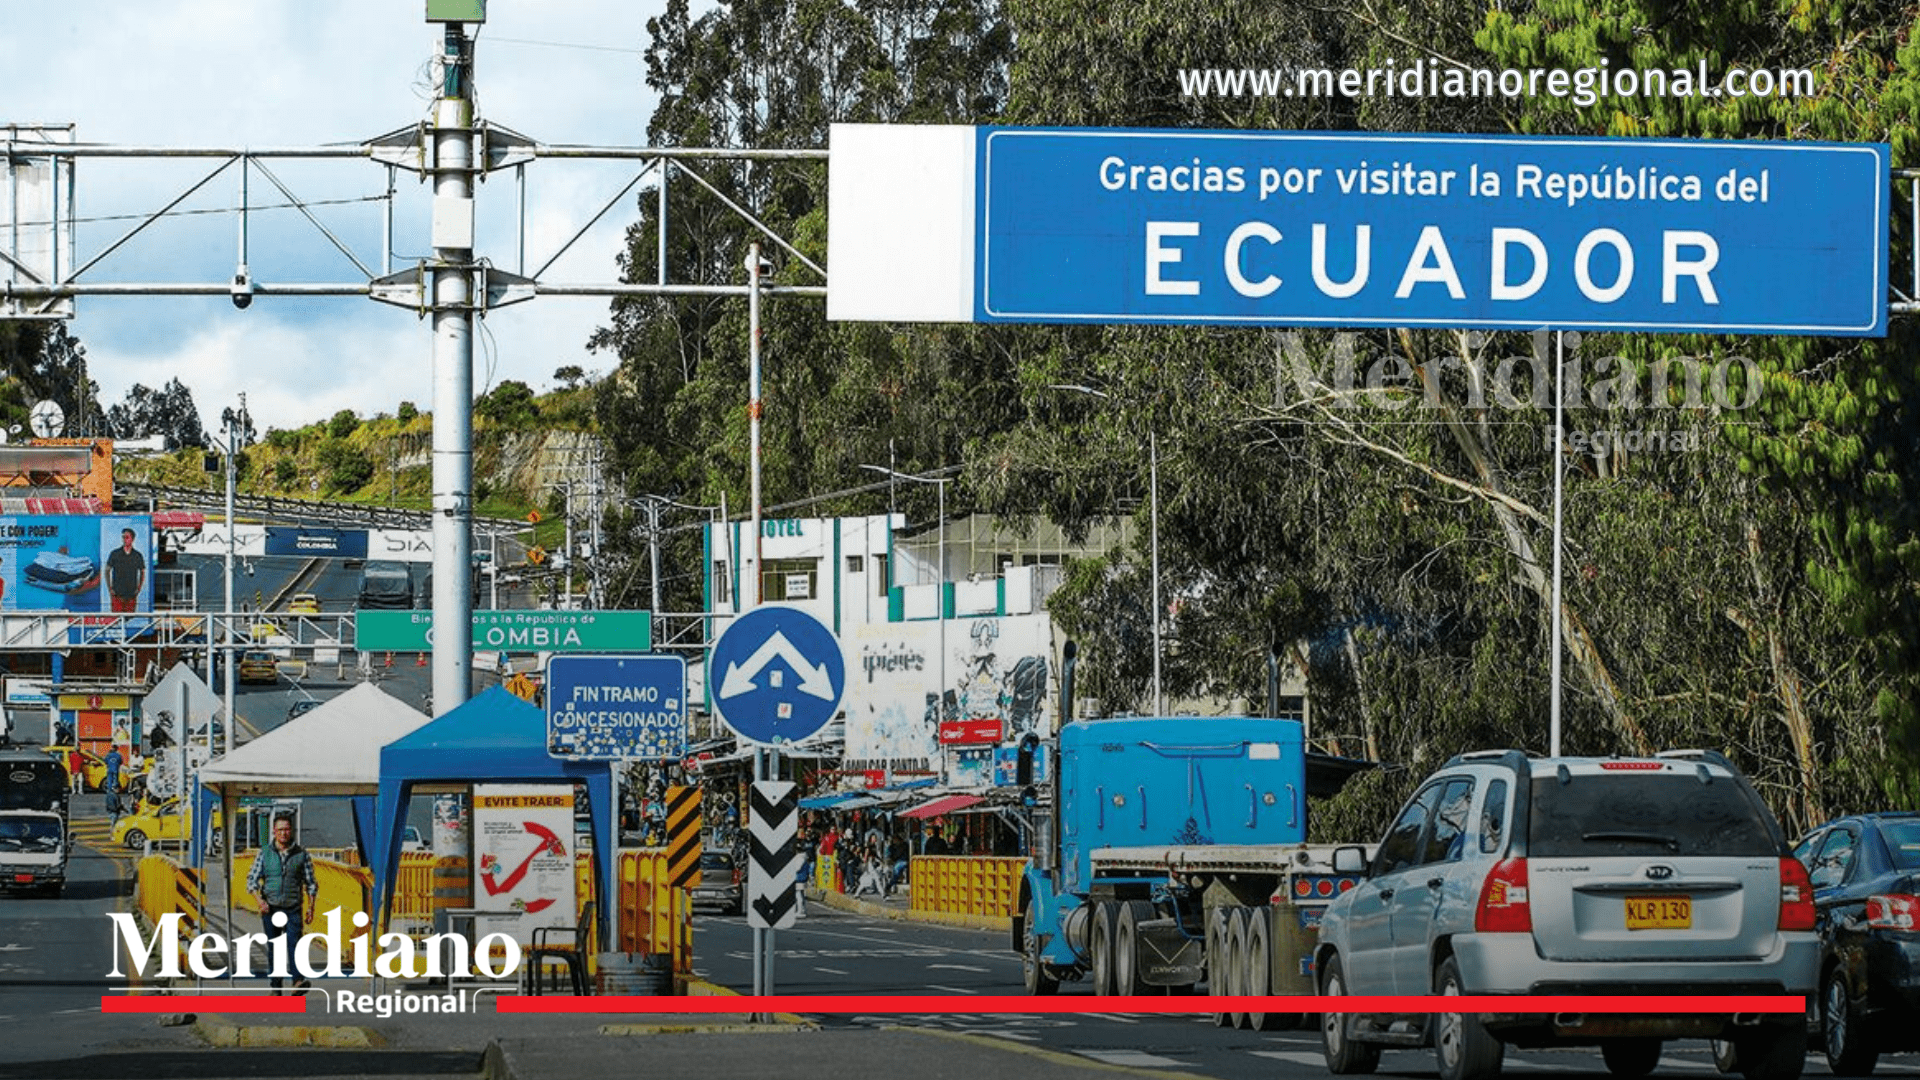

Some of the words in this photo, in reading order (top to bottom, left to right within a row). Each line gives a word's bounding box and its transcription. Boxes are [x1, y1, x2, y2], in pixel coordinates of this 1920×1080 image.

[1099, 156, 1245, 191] Gracias
[1259, 167, 1322, 201] por
[1336, 161, 1456, 196] visitar
[1469, 163, 1500, 197] la
[1516, 164, 1702, 207] República
[1715, 168, 1769, 203] del
[1144, 219, 1720, 306] ECUADOR
[581, 614, 596, 623] de
[425, 627, 582, 646] OMBIA
[573, 686, 598, 702] FIN
[601, 686, 659, 702] TRAMO
[553, 711, 680, 728] CONCESIONADO
[484, 797, 519, 808] EVITE
[522, 797, 565, 808] TRAER:
[1626, 902, 1656, 920] KLR
[1660, 902, 1689, 920] 130
